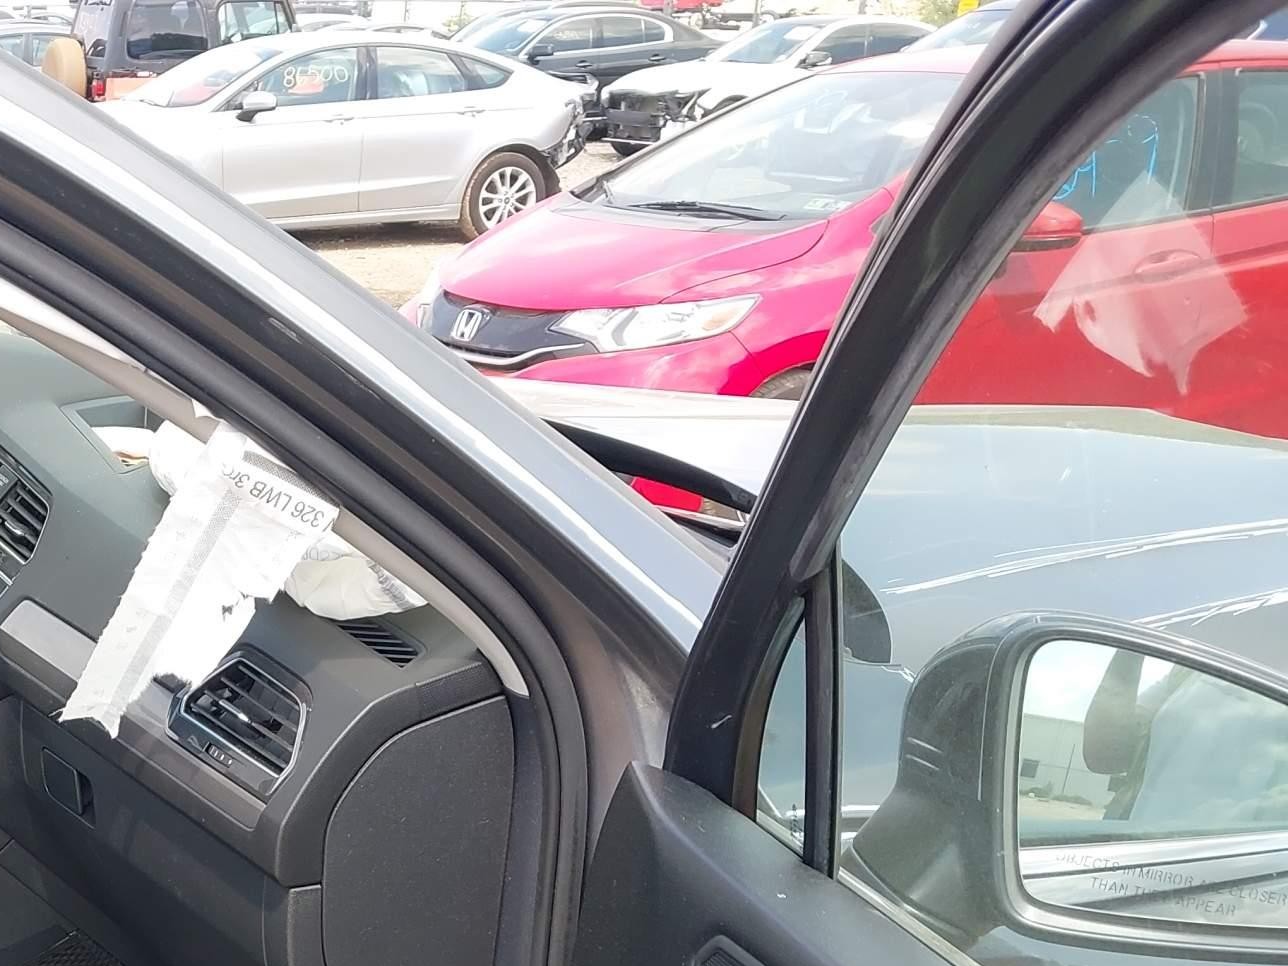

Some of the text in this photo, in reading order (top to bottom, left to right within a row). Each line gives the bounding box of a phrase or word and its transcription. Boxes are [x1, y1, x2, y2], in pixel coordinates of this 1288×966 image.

[249, 480, 293, 512] LWB
[290, 500, 325, 528] 326
[1138, 865, 1195, 887] MIRROR
[1089, 876, 1129, 896] THAN
[1174, 895, 1237, 917] APPEAR
